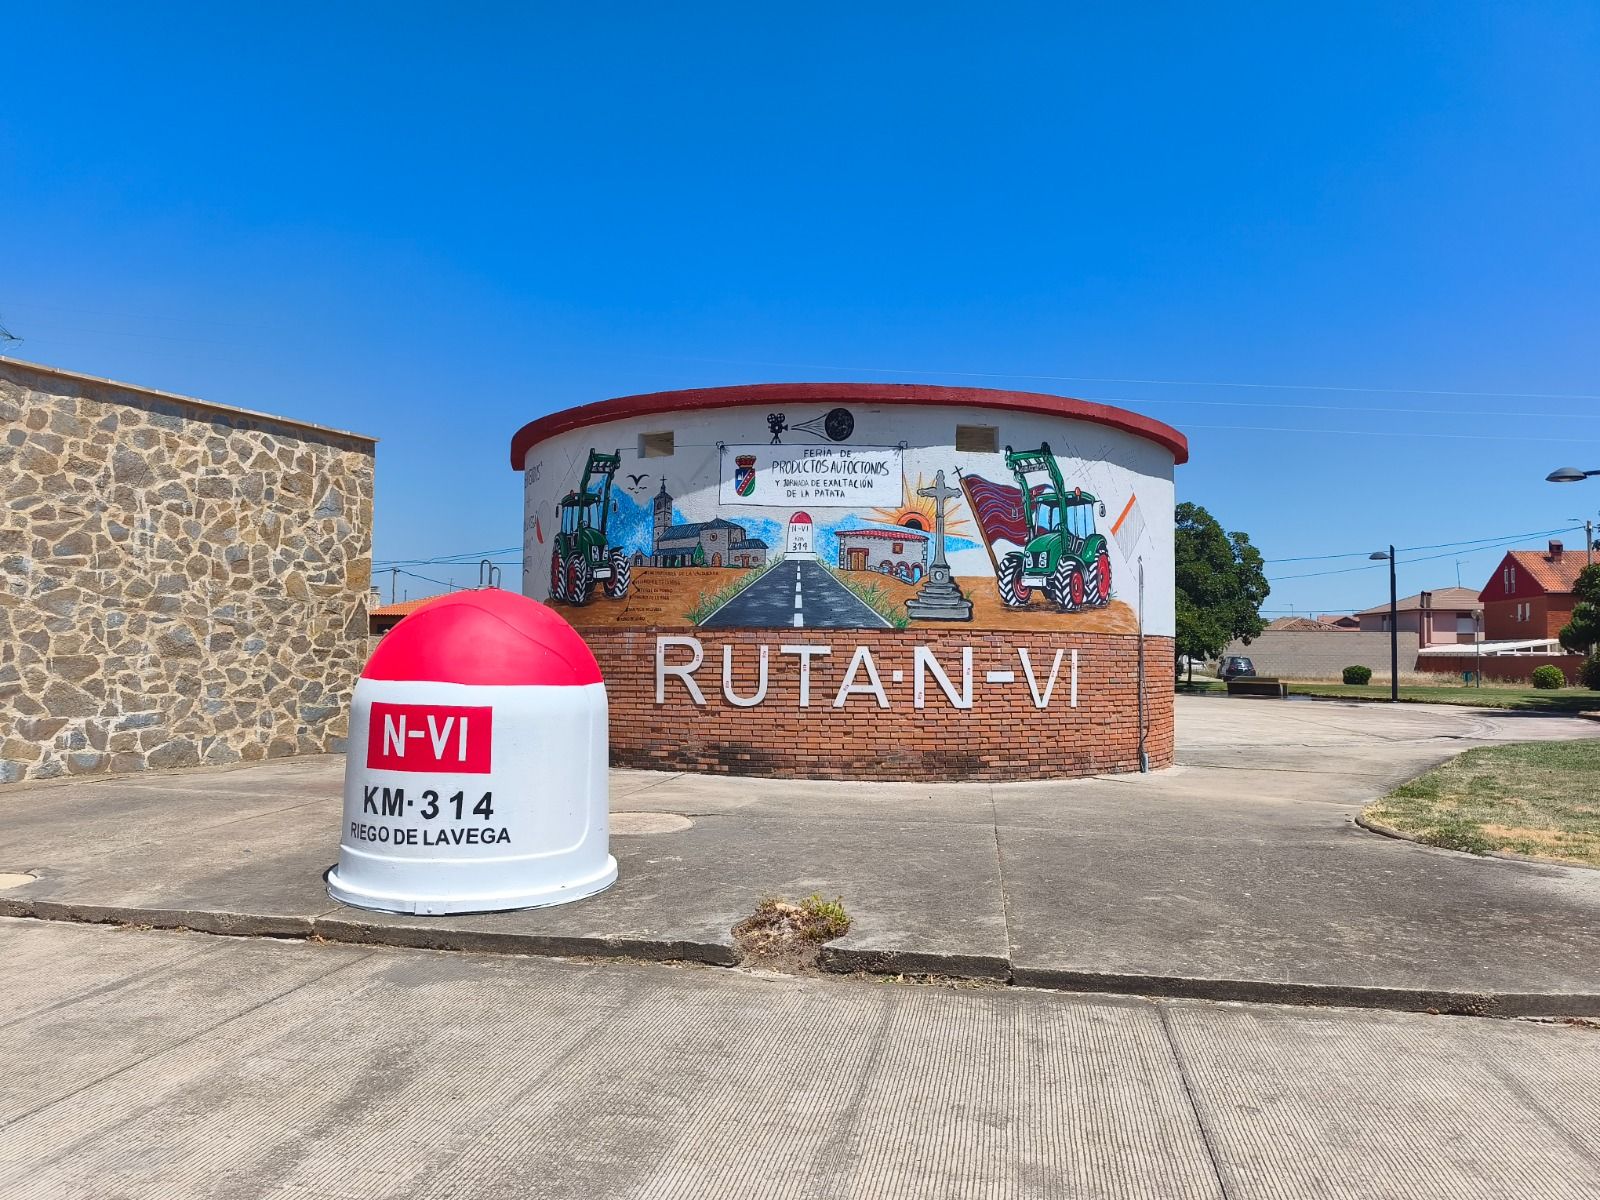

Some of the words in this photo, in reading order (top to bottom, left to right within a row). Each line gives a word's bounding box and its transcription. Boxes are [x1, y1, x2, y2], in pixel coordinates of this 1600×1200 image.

[840, 449, 851, 457] DE
[771, 459, 829, 474] PRODUCTOS
[811, 479, 821, 487] DE
[823, 475, 873, 488] EXALTACIÓN
[786, 489, 797, 497] DE
[815, 489, 845, 497] PATATA
[383, 713, 468, 762] N-VI
[350, 821, 390, 842] RIEGO
[393, 828, 418, 845] DE
